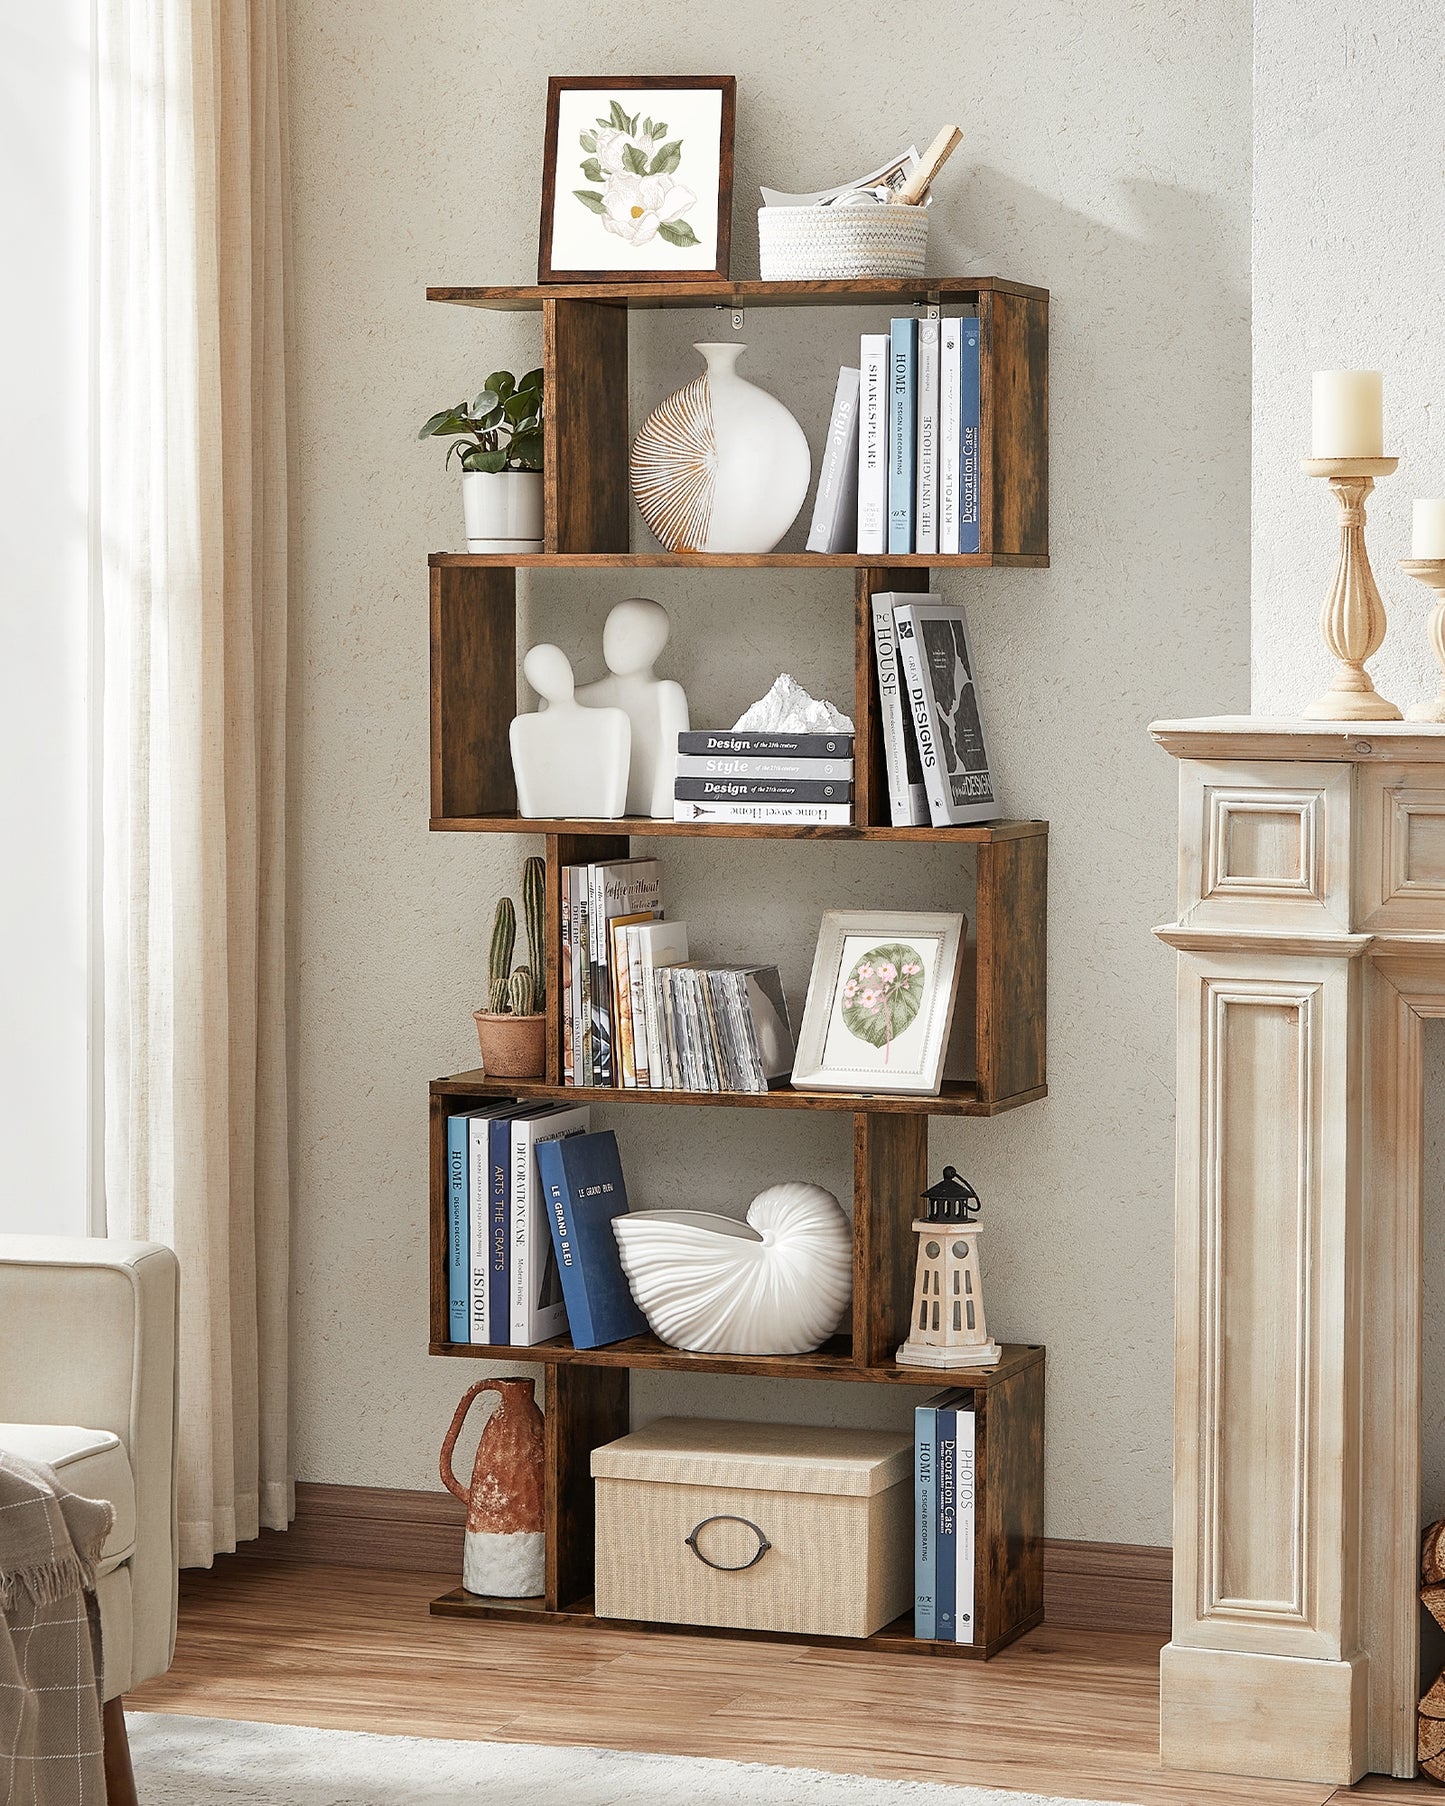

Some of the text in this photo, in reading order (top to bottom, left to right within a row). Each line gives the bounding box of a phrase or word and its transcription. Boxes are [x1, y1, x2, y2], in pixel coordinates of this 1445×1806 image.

[896, 353, 906, 394] HOME
[833, 400, 851, 446] Style
[867, 364, 878, 470] SHAKESPEARE
[922, 416, 932, 536] THE VINTAGE HOUSE
[945, 473, 953, 523] KINFOLK
[962, 427, 973, 524] Decoration Case
[875, 613, 890, 623] PC
[878, 627, 897, 697] HOUSE
[908, 655, 936, 768] GREAT DESIGNS
[706, 737, 751, 751] Design
[706, 760, 749, 775] Style
[704, 782, 748, 795] Design
[729, 807, 828, 820] Home sweet Home
[451, 1150, 462, 1191] HOME
[515, 1142, 527, 1247] DECORATION CASE
[578, 1184, 614, 1198] LE GRAND BLEU
[494, 1166, 504, 1271] ARTS THE CRAFTS
[551, 1185, 573, 1267] LE GRAND BLEU
[473, 1267, 485, 1322] HOUSE
[516, 1286, 524, 1306] living
[919, 1442, 931, 1483] HOME
[945, 1440, 955, 1534] Decoration Case
[960, 1449, 974, 1509] PHOTOS
